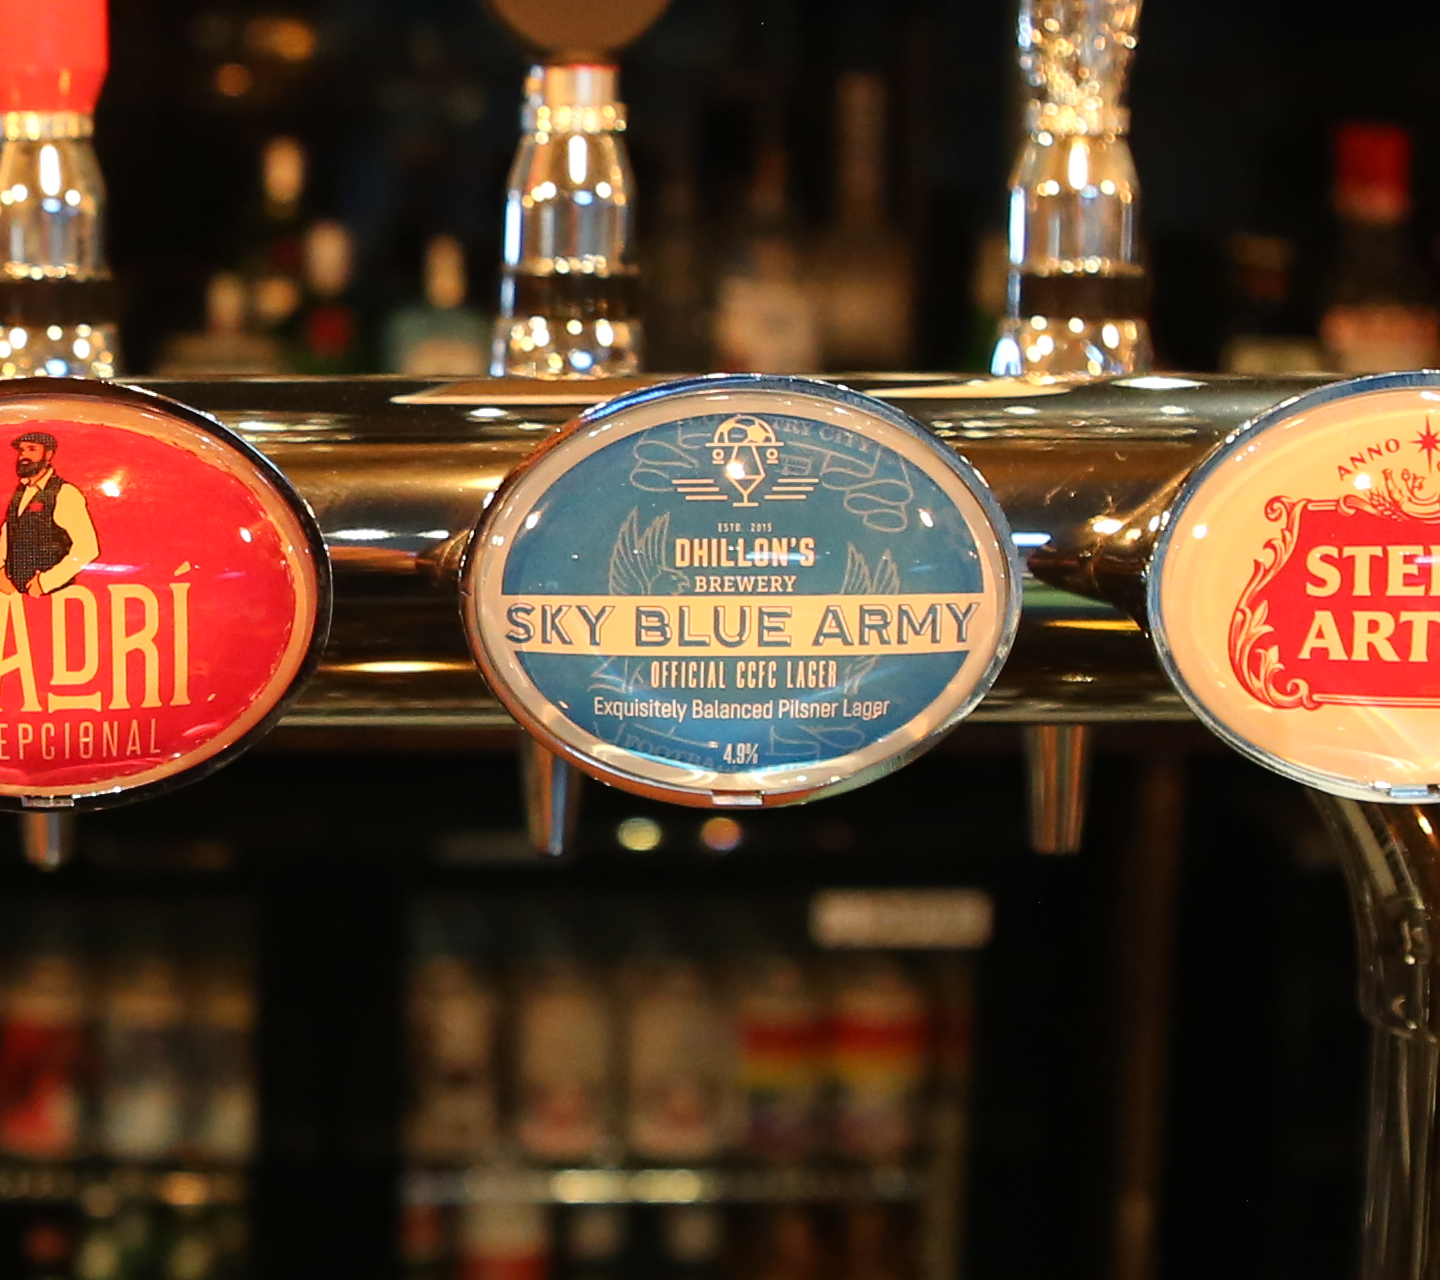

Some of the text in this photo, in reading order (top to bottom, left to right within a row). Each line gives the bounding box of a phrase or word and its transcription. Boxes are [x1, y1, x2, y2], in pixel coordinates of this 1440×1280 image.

[1335, 436, 1401, 481] ANNO
[674, 537, 816, 568] DHILLON'S
[693, 575, 798, 593] BREWERY
[505, 601, 980, 648] SKY BLUE ARMY
[650, 660, 838, 689] OFFICIAL CCFC LAGER
[594, 696, 890, 724] Exquisitely Balanced Pilsner Lager
[723, 742, 759, 765] 4.9%
